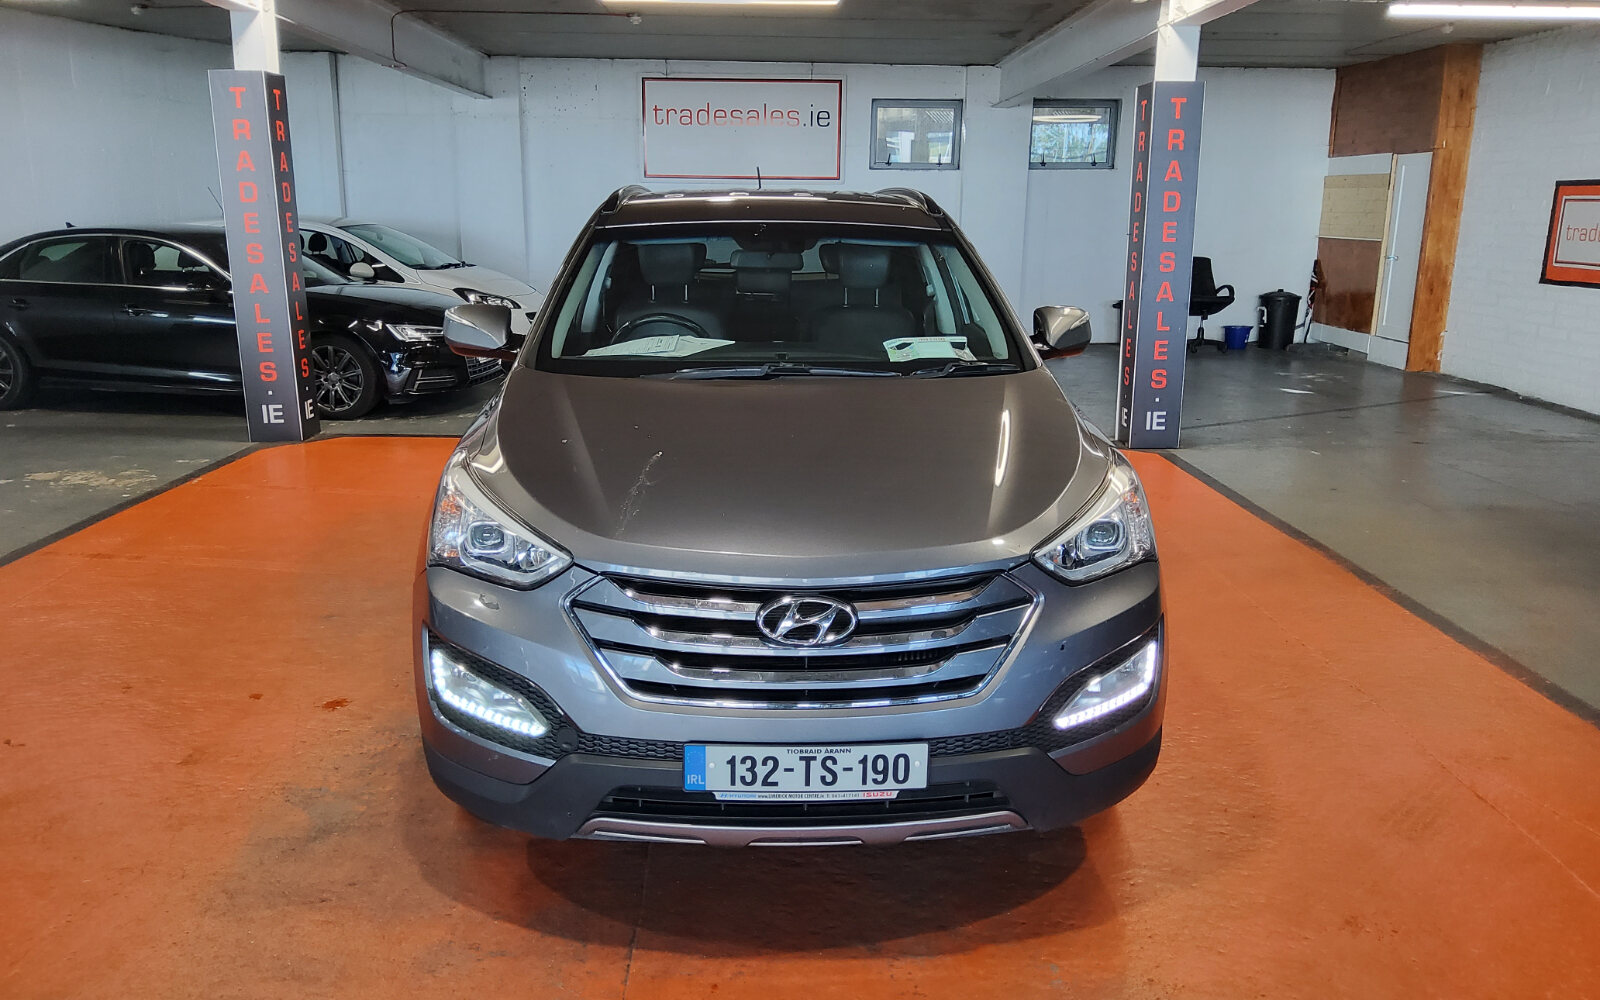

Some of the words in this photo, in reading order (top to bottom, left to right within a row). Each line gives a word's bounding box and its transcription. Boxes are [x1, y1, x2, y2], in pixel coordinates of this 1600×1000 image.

[652, 102, 831, 127] tradesales.ie
[1566, 223, 1600, 242] trad
[687, 774, 705, 785] IRL
[726, 753, 911, 787] 132-TS-190
